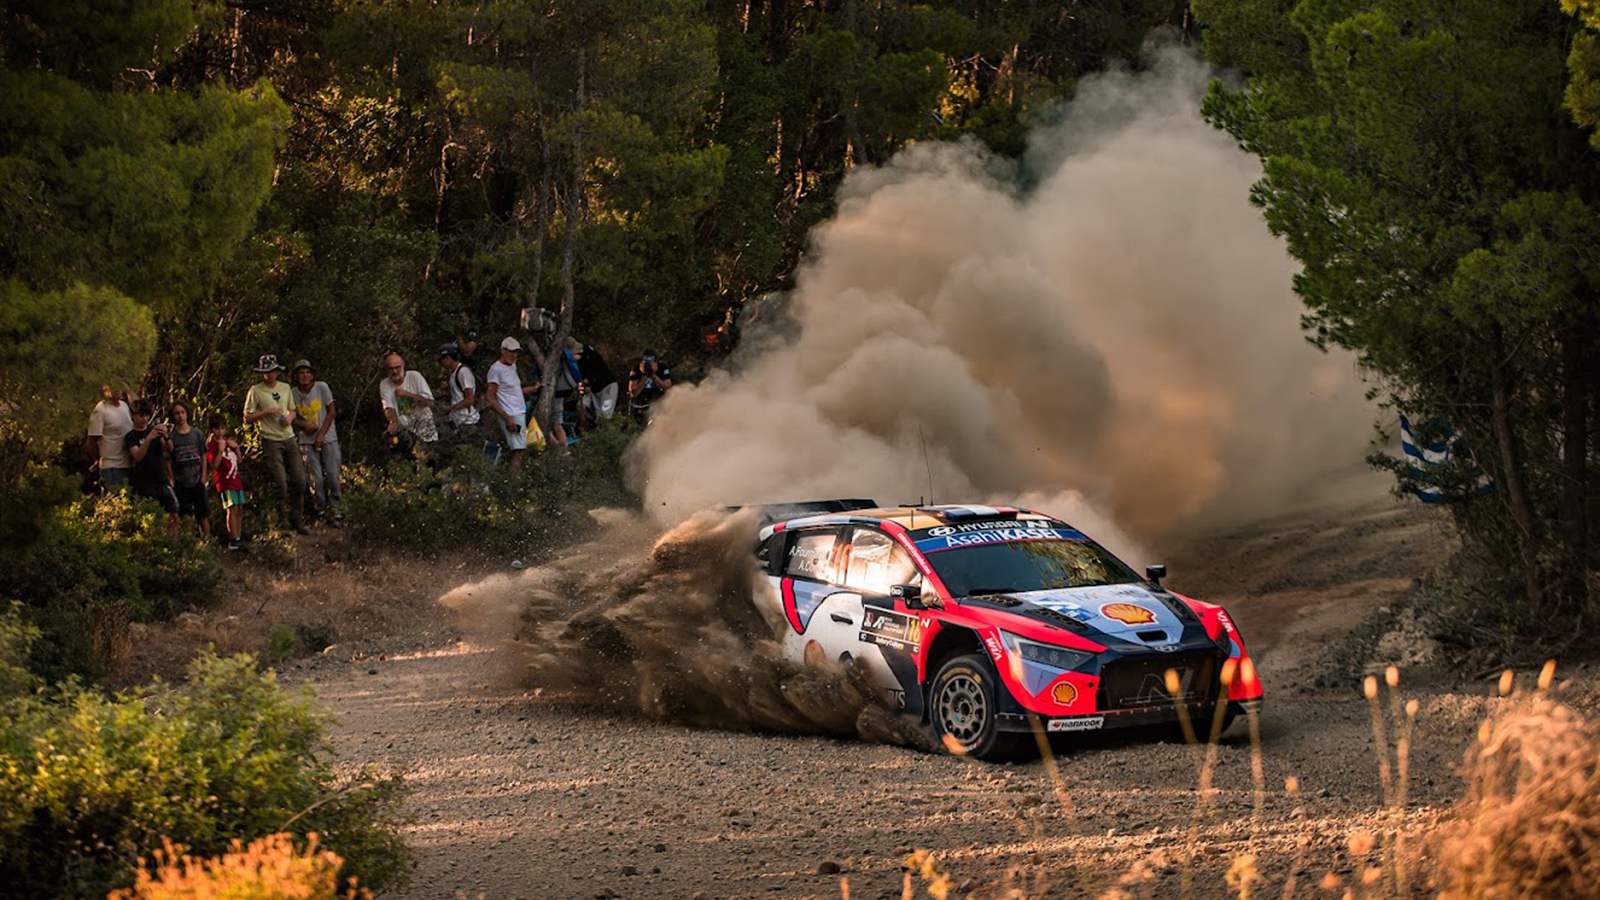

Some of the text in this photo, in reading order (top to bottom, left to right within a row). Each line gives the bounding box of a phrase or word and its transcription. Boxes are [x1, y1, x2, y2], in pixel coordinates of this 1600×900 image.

[957, 520, 1022, 532] HYUNDAI
[945, 528, 1064, 547] AsahiKASEI
[920, 617, 931, 628] N
[907, 618, 920, 643] 16
